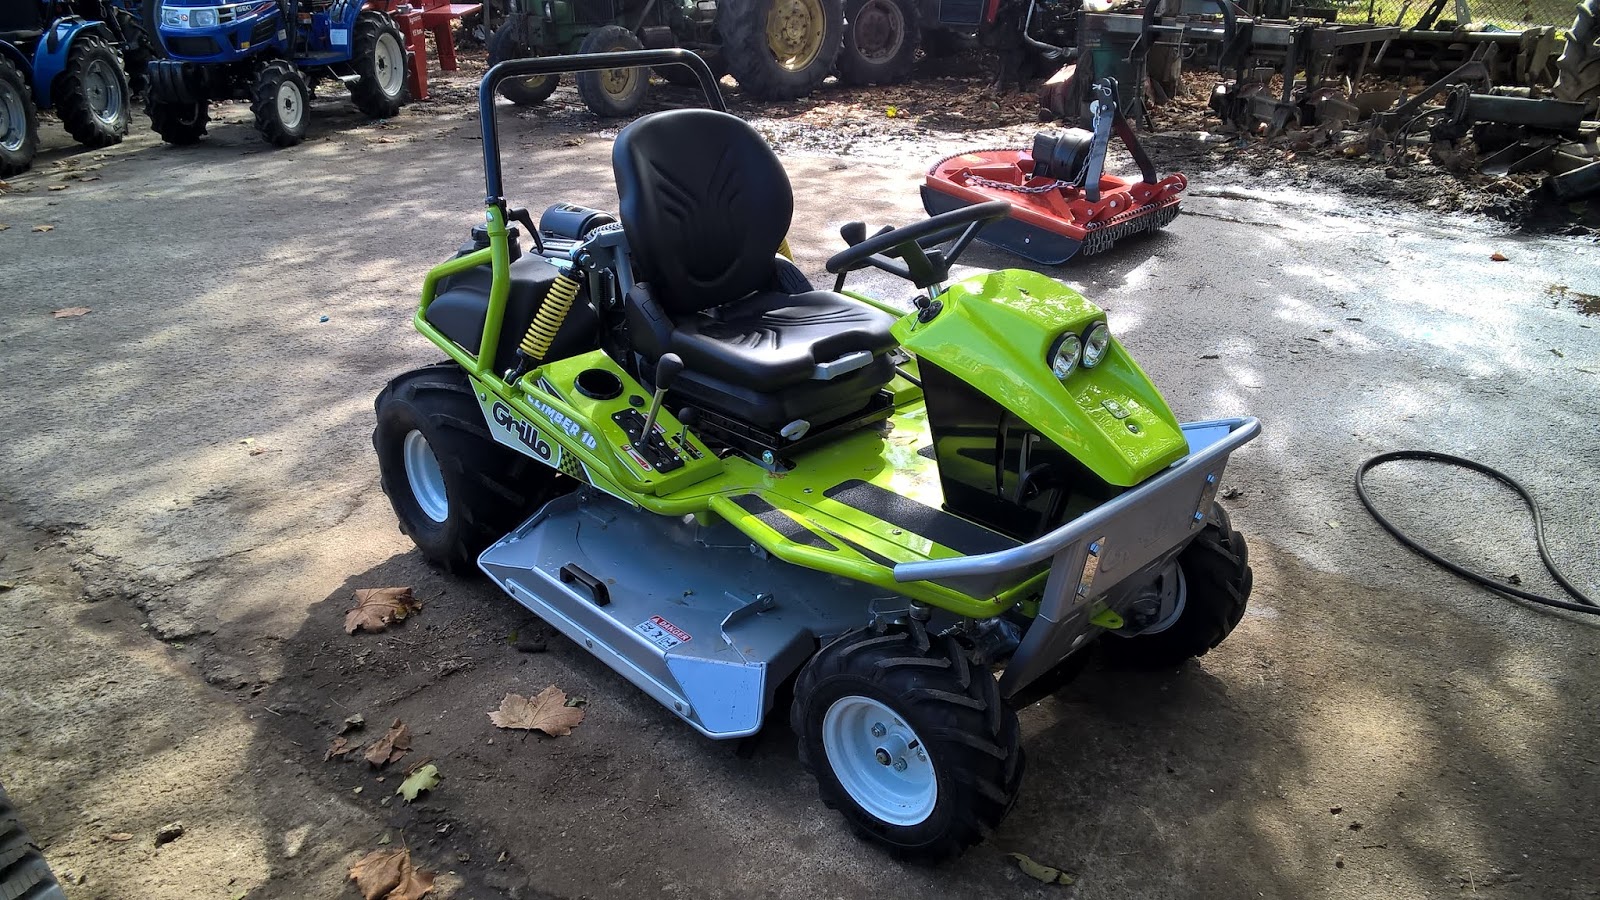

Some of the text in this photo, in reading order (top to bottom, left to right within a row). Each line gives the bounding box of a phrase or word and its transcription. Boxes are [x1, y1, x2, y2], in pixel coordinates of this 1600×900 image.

[492, 401, 552, 461] Grillo
[527, 394, 580, 436] CLIMBER
[659, 620, 689, 641] DANGER
